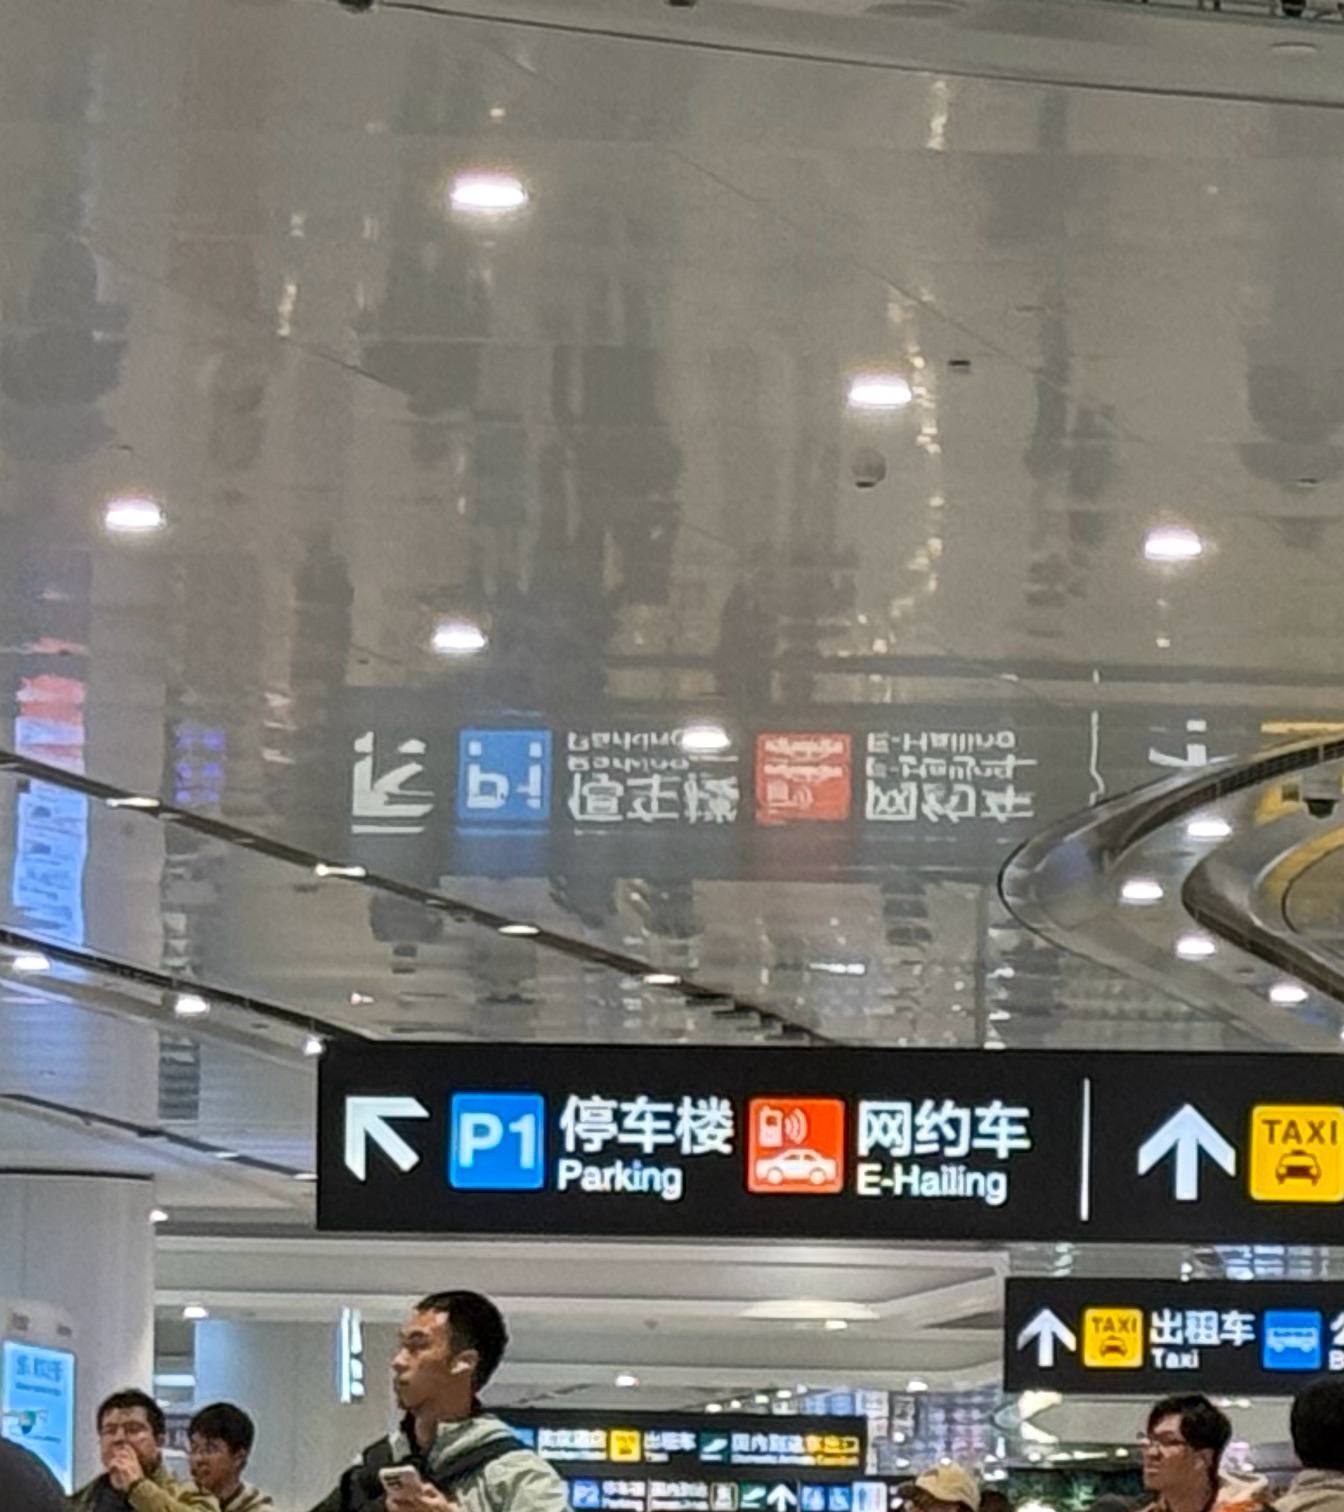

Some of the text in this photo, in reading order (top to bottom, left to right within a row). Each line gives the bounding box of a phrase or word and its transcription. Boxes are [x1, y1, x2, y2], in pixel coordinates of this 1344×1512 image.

[460, 1112, 534, 1168] P1
[559, 1094, 734, 1155] 停车楼
[857, 1099, 1031, 1159] 网约车
[1261, 1119, 1338, 1145] TAXI
[558, 1158, 683, 1201] Parking
[857, 1162, 1007, 1206] E-Hailing
[1092, 1316, 1137, 1333] TAXI
[1150, 1308, 1255, 1346] 出租车
[1151, 1347, 1199, 1369] Taxi
